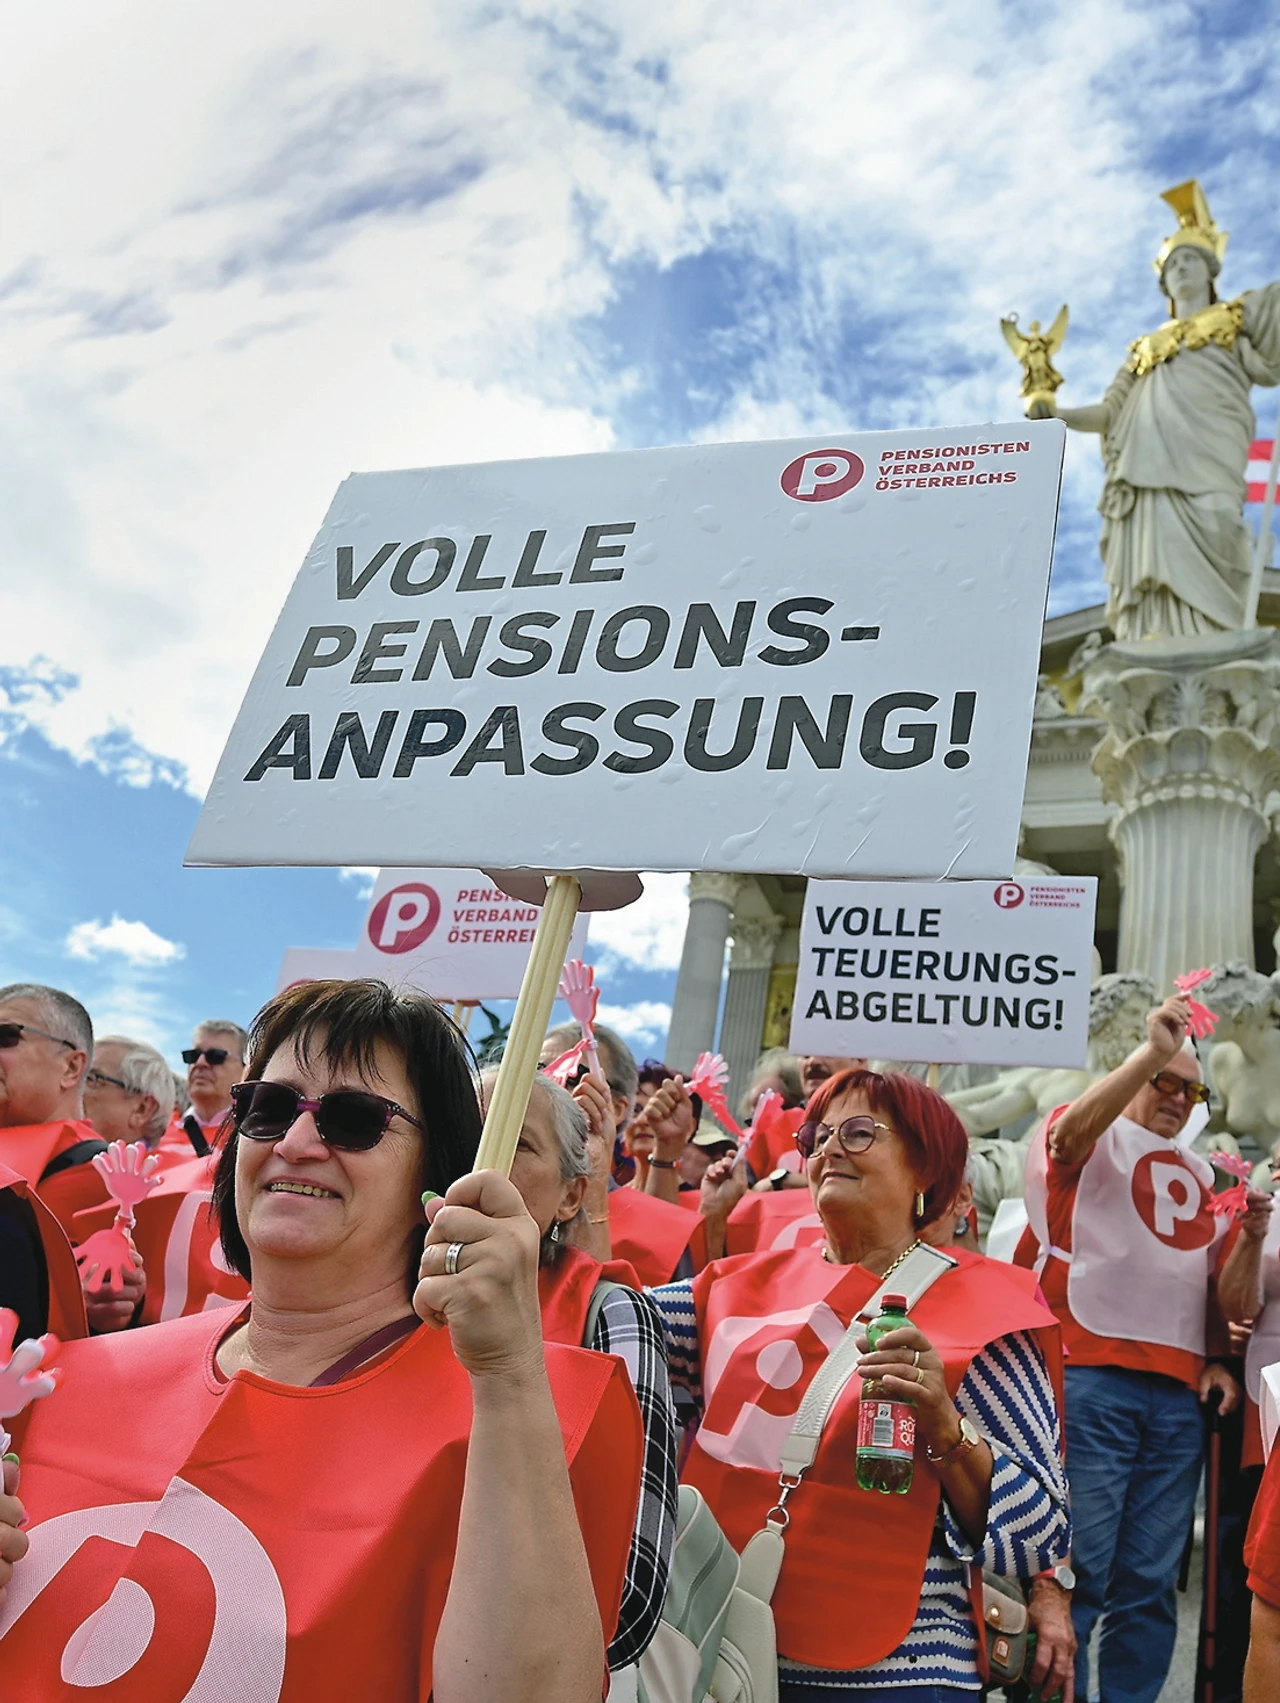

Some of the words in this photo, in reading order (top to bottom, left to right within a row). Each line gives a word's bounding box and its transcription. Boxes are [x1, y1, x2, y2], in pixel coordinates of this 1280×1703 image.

[881, 441, 1030, 462] PENSIONISTEN
[875, 472, 1017, 491] ÖSTERREICHS
[879, 460, 975, 476] VERBAND
[335, 521, 636, 601] VOLLE
[285, 597, 880, 688] PENSIONS-
[243, 690, 977, 783] ANPASSUNG!
[453, 909, 538, 922] VERBAND
[816, 906, 941, 937] VOLLE
[447, 926, 537, 943] ÖSTERREI
[811, 947, 1076, 985] TEUERUNGS-
[805, 990, 1063, 1031] ABGELTUNG!
